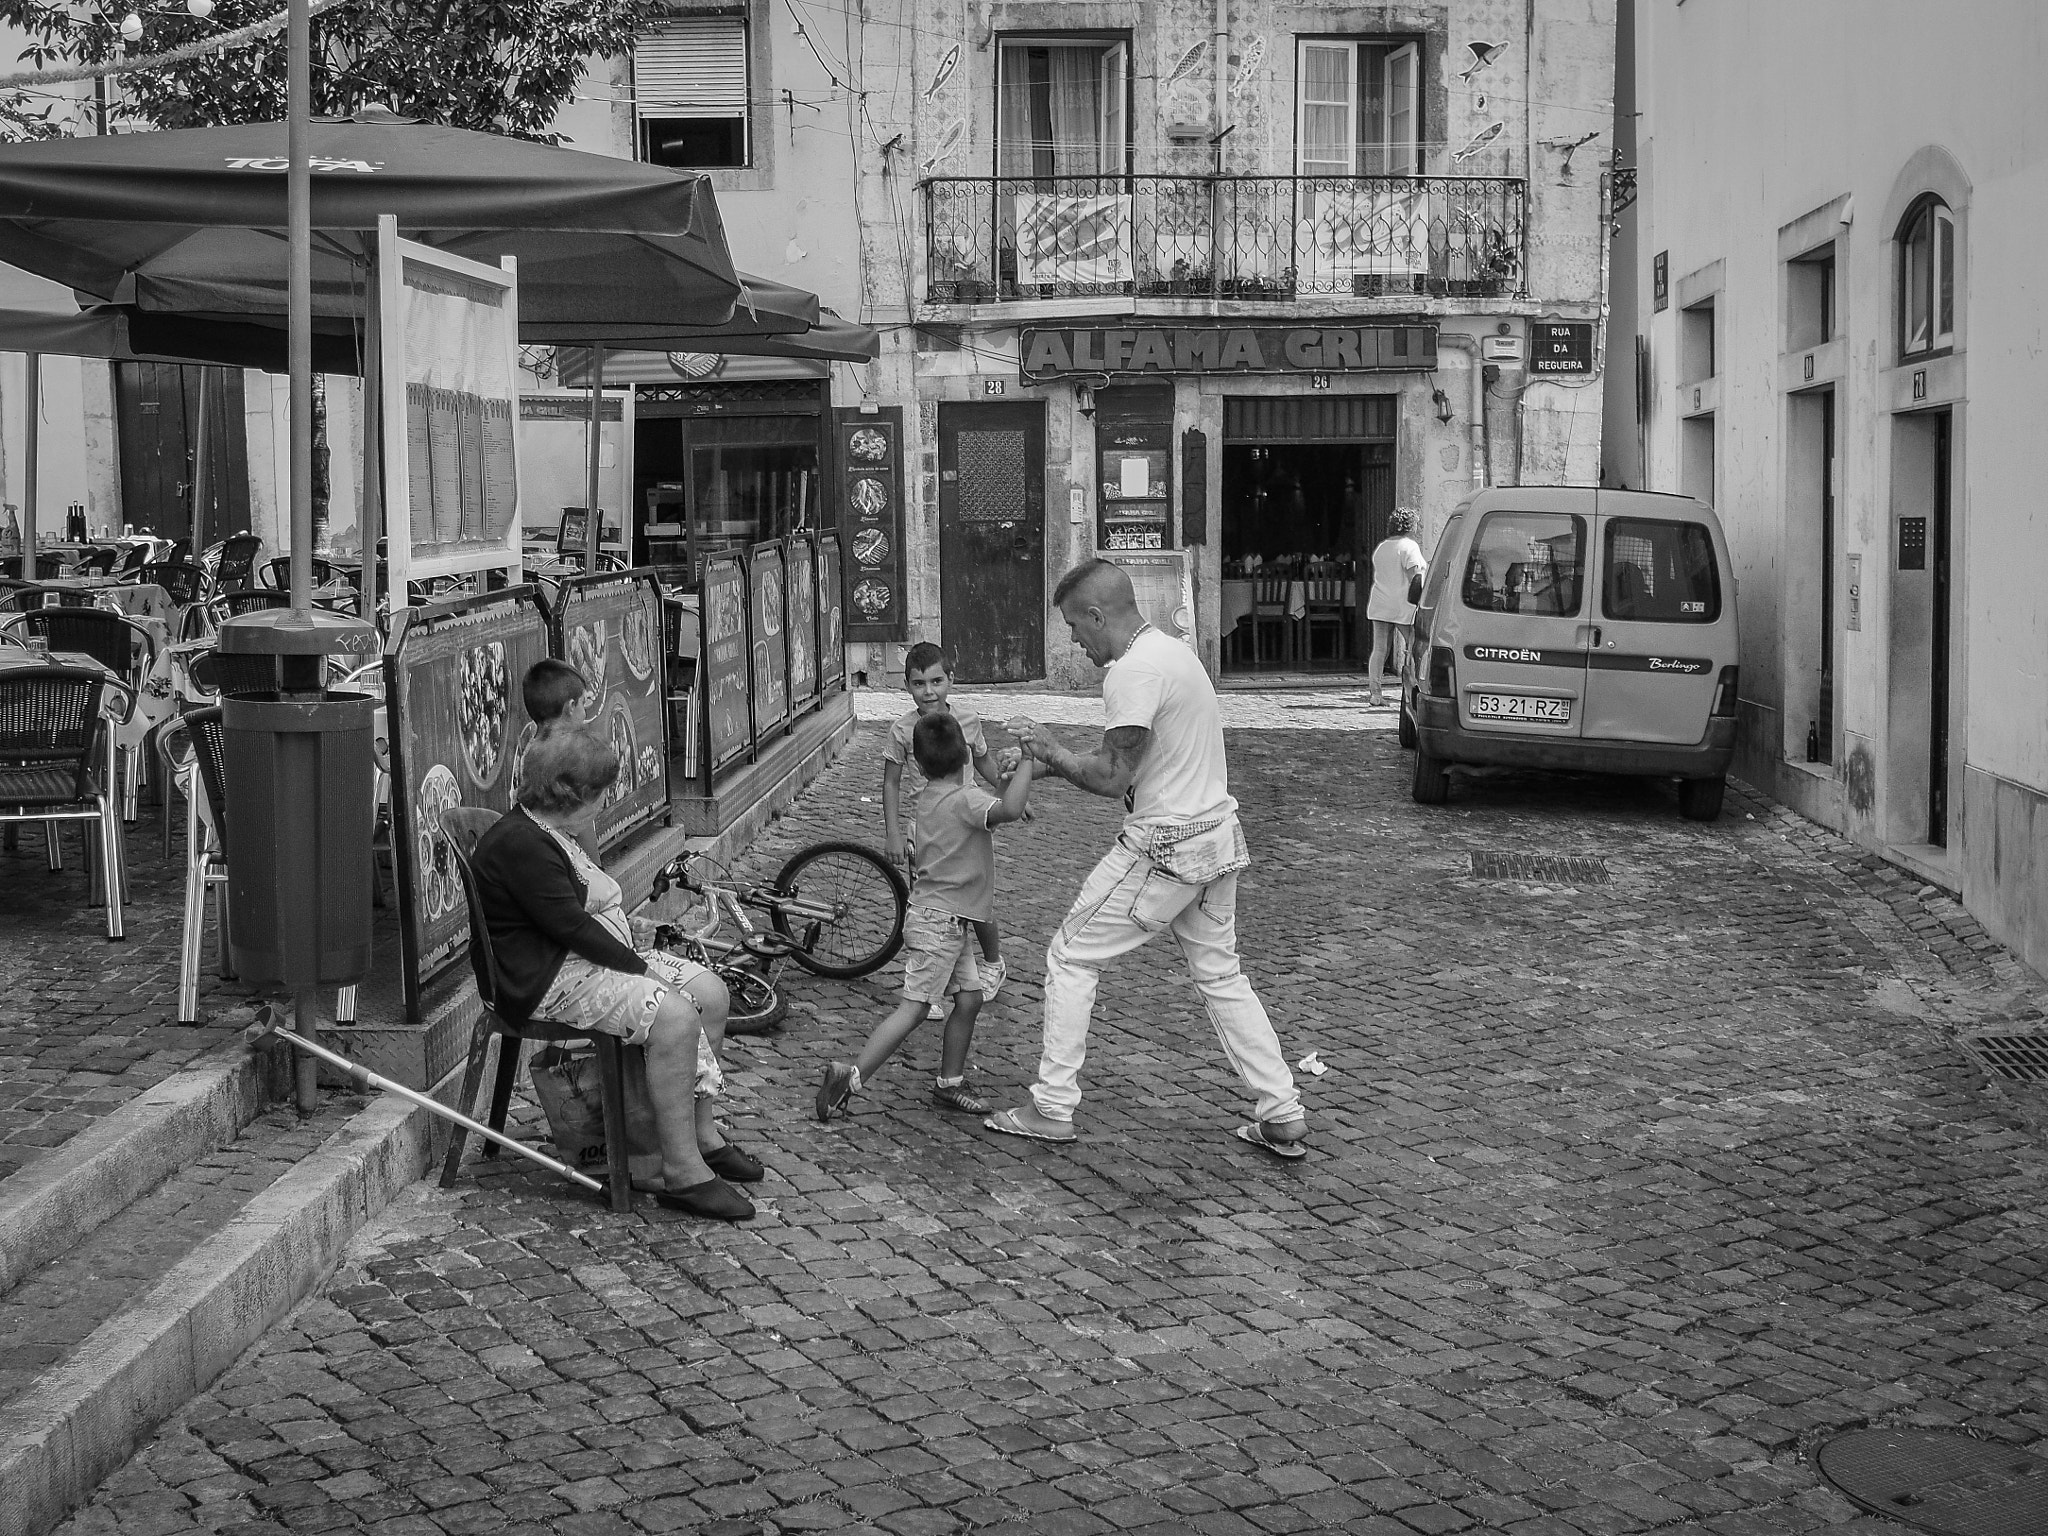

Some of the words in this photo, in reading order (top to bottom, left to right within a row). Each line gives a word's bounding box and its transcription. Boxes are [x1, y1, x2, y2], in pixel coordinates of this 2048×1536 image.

[1551, 327, 1571, 337] RUA
[1025, 328, 1266, 370] ALFAMA
[1284, 329, 1439, 368] GRILL
[1553, 344, 1568, 353] DA
[1538, 361, 1583, 370] REGUEIRA
[987, 381, 1002, 394] 28
[1313, 375, 1328, 389] 26
[1474, 647, 1541, 662] CITROËN
[1649, 658, 1701, 673] Berlingo
